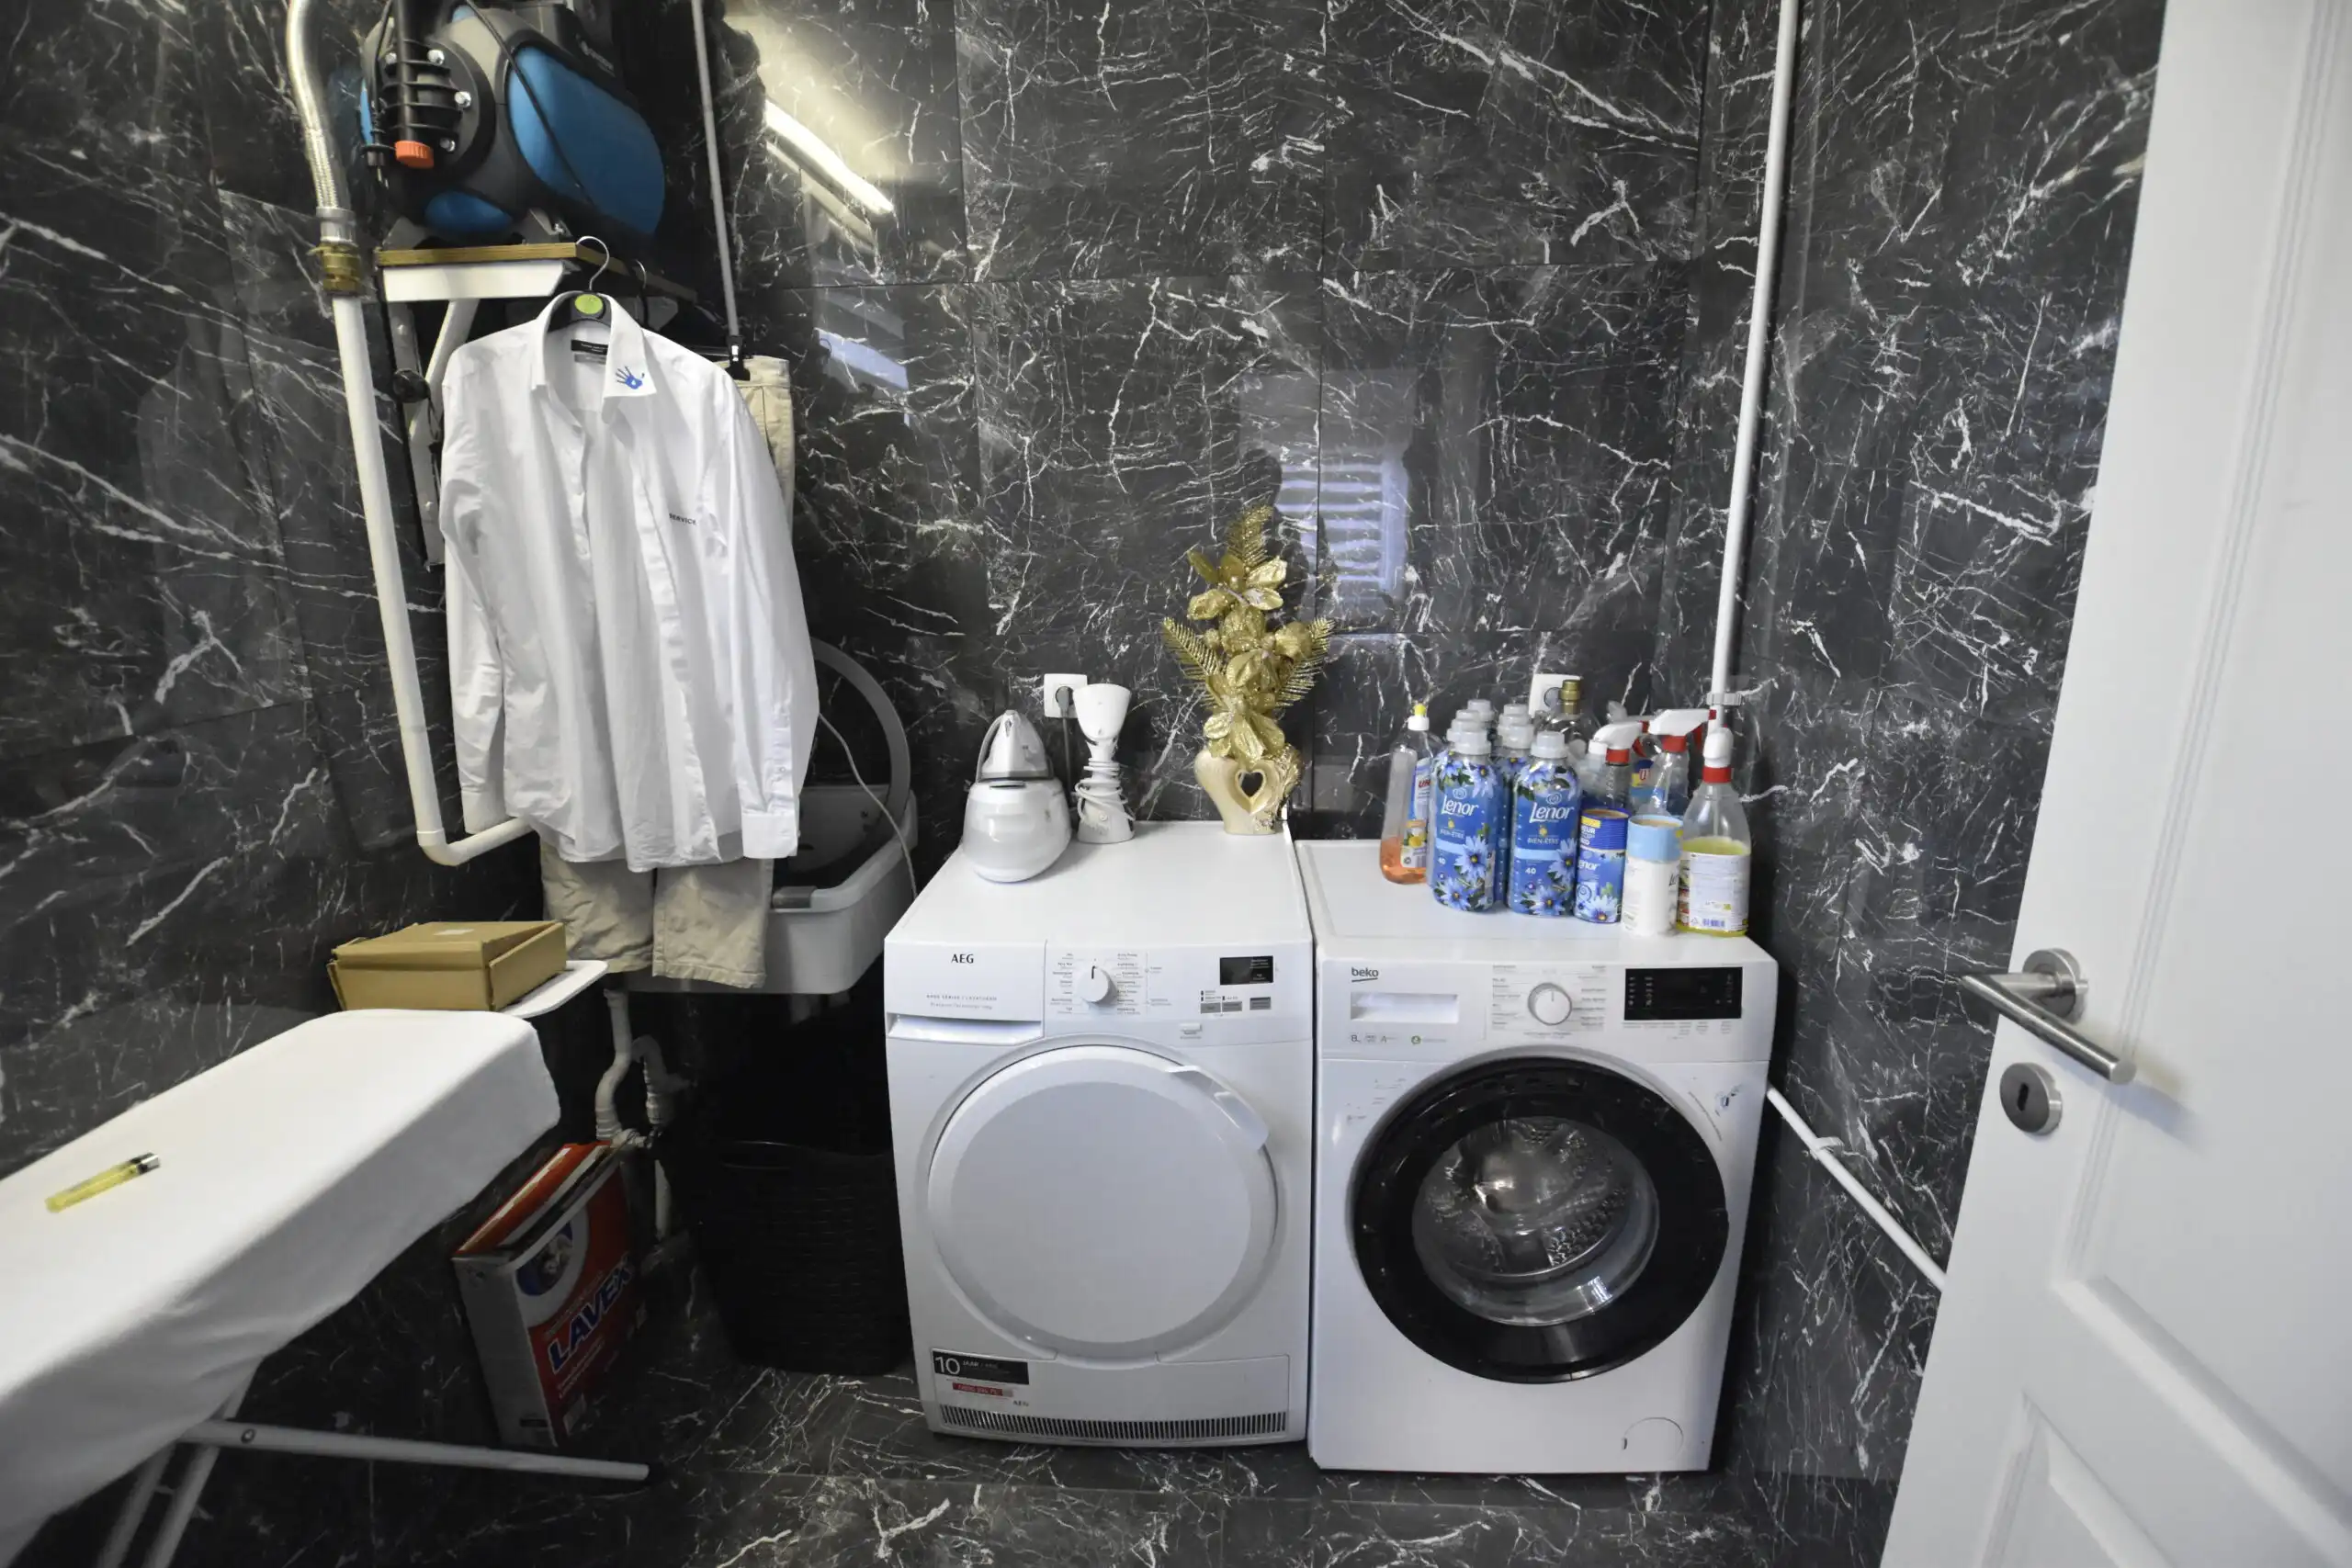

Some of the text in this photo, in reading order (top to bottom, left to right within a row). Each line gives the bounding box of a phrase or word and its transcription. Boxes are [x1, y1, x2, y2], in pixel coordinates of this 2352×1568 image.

[1441, 795, 1479, 817] Lenor
[1529, 802, 1574, 823] Lenor
[1577, 860, 1600, 871] enor
[951, 953, 975, 964] AEG
[1351, 966, 1379, 978] beko
[548, 1250, 634, 1375] LAVEX
[934, 1357, 961, 1375] 10
